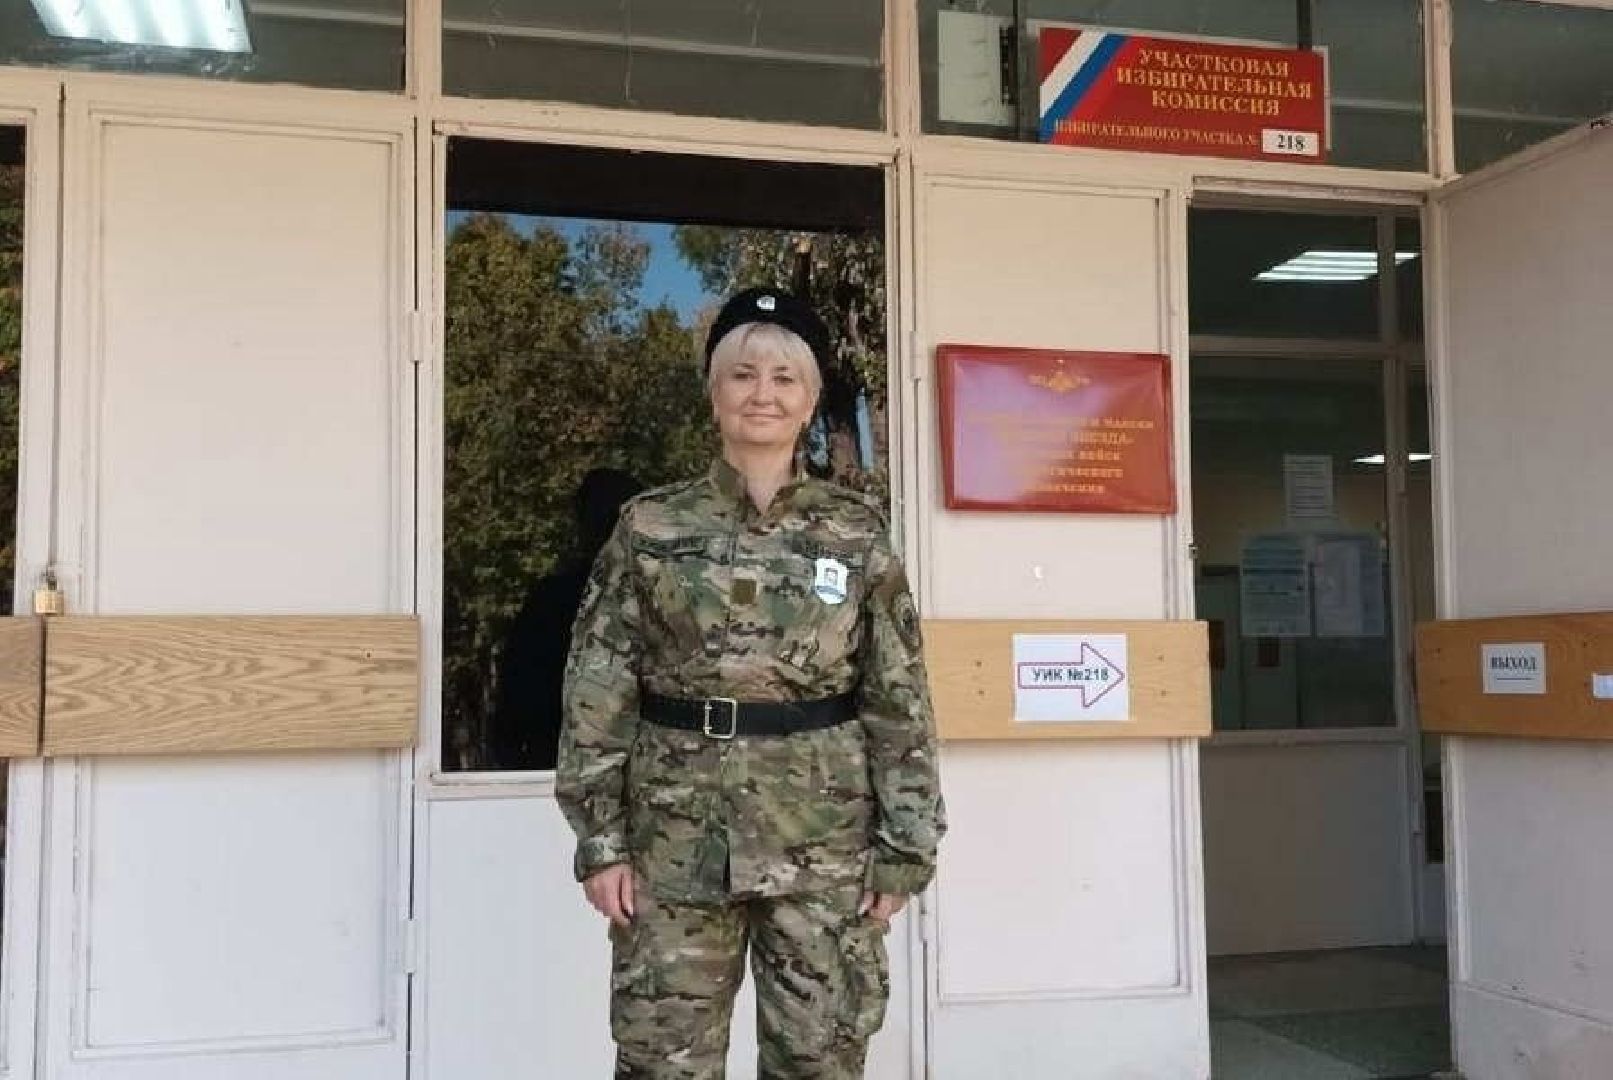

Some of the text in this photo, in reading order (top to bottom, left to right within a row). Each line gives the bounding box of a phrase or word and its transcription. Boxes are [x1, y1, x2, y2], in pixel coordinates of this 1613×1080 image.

[1138, 48, 1289, 78] УЧАСТКОВАЯ
[1116, 67, 1312, 99] ИЗБИРАТЕЛЬНАЯ
[1151, 90, 1280, 116] КОМИССИЯ
[1276, 133, 1306, 151] 218
[1491, 655, 1536, 671] ВЫХОД
[1032, 667, 1109, 682] УИК №218
